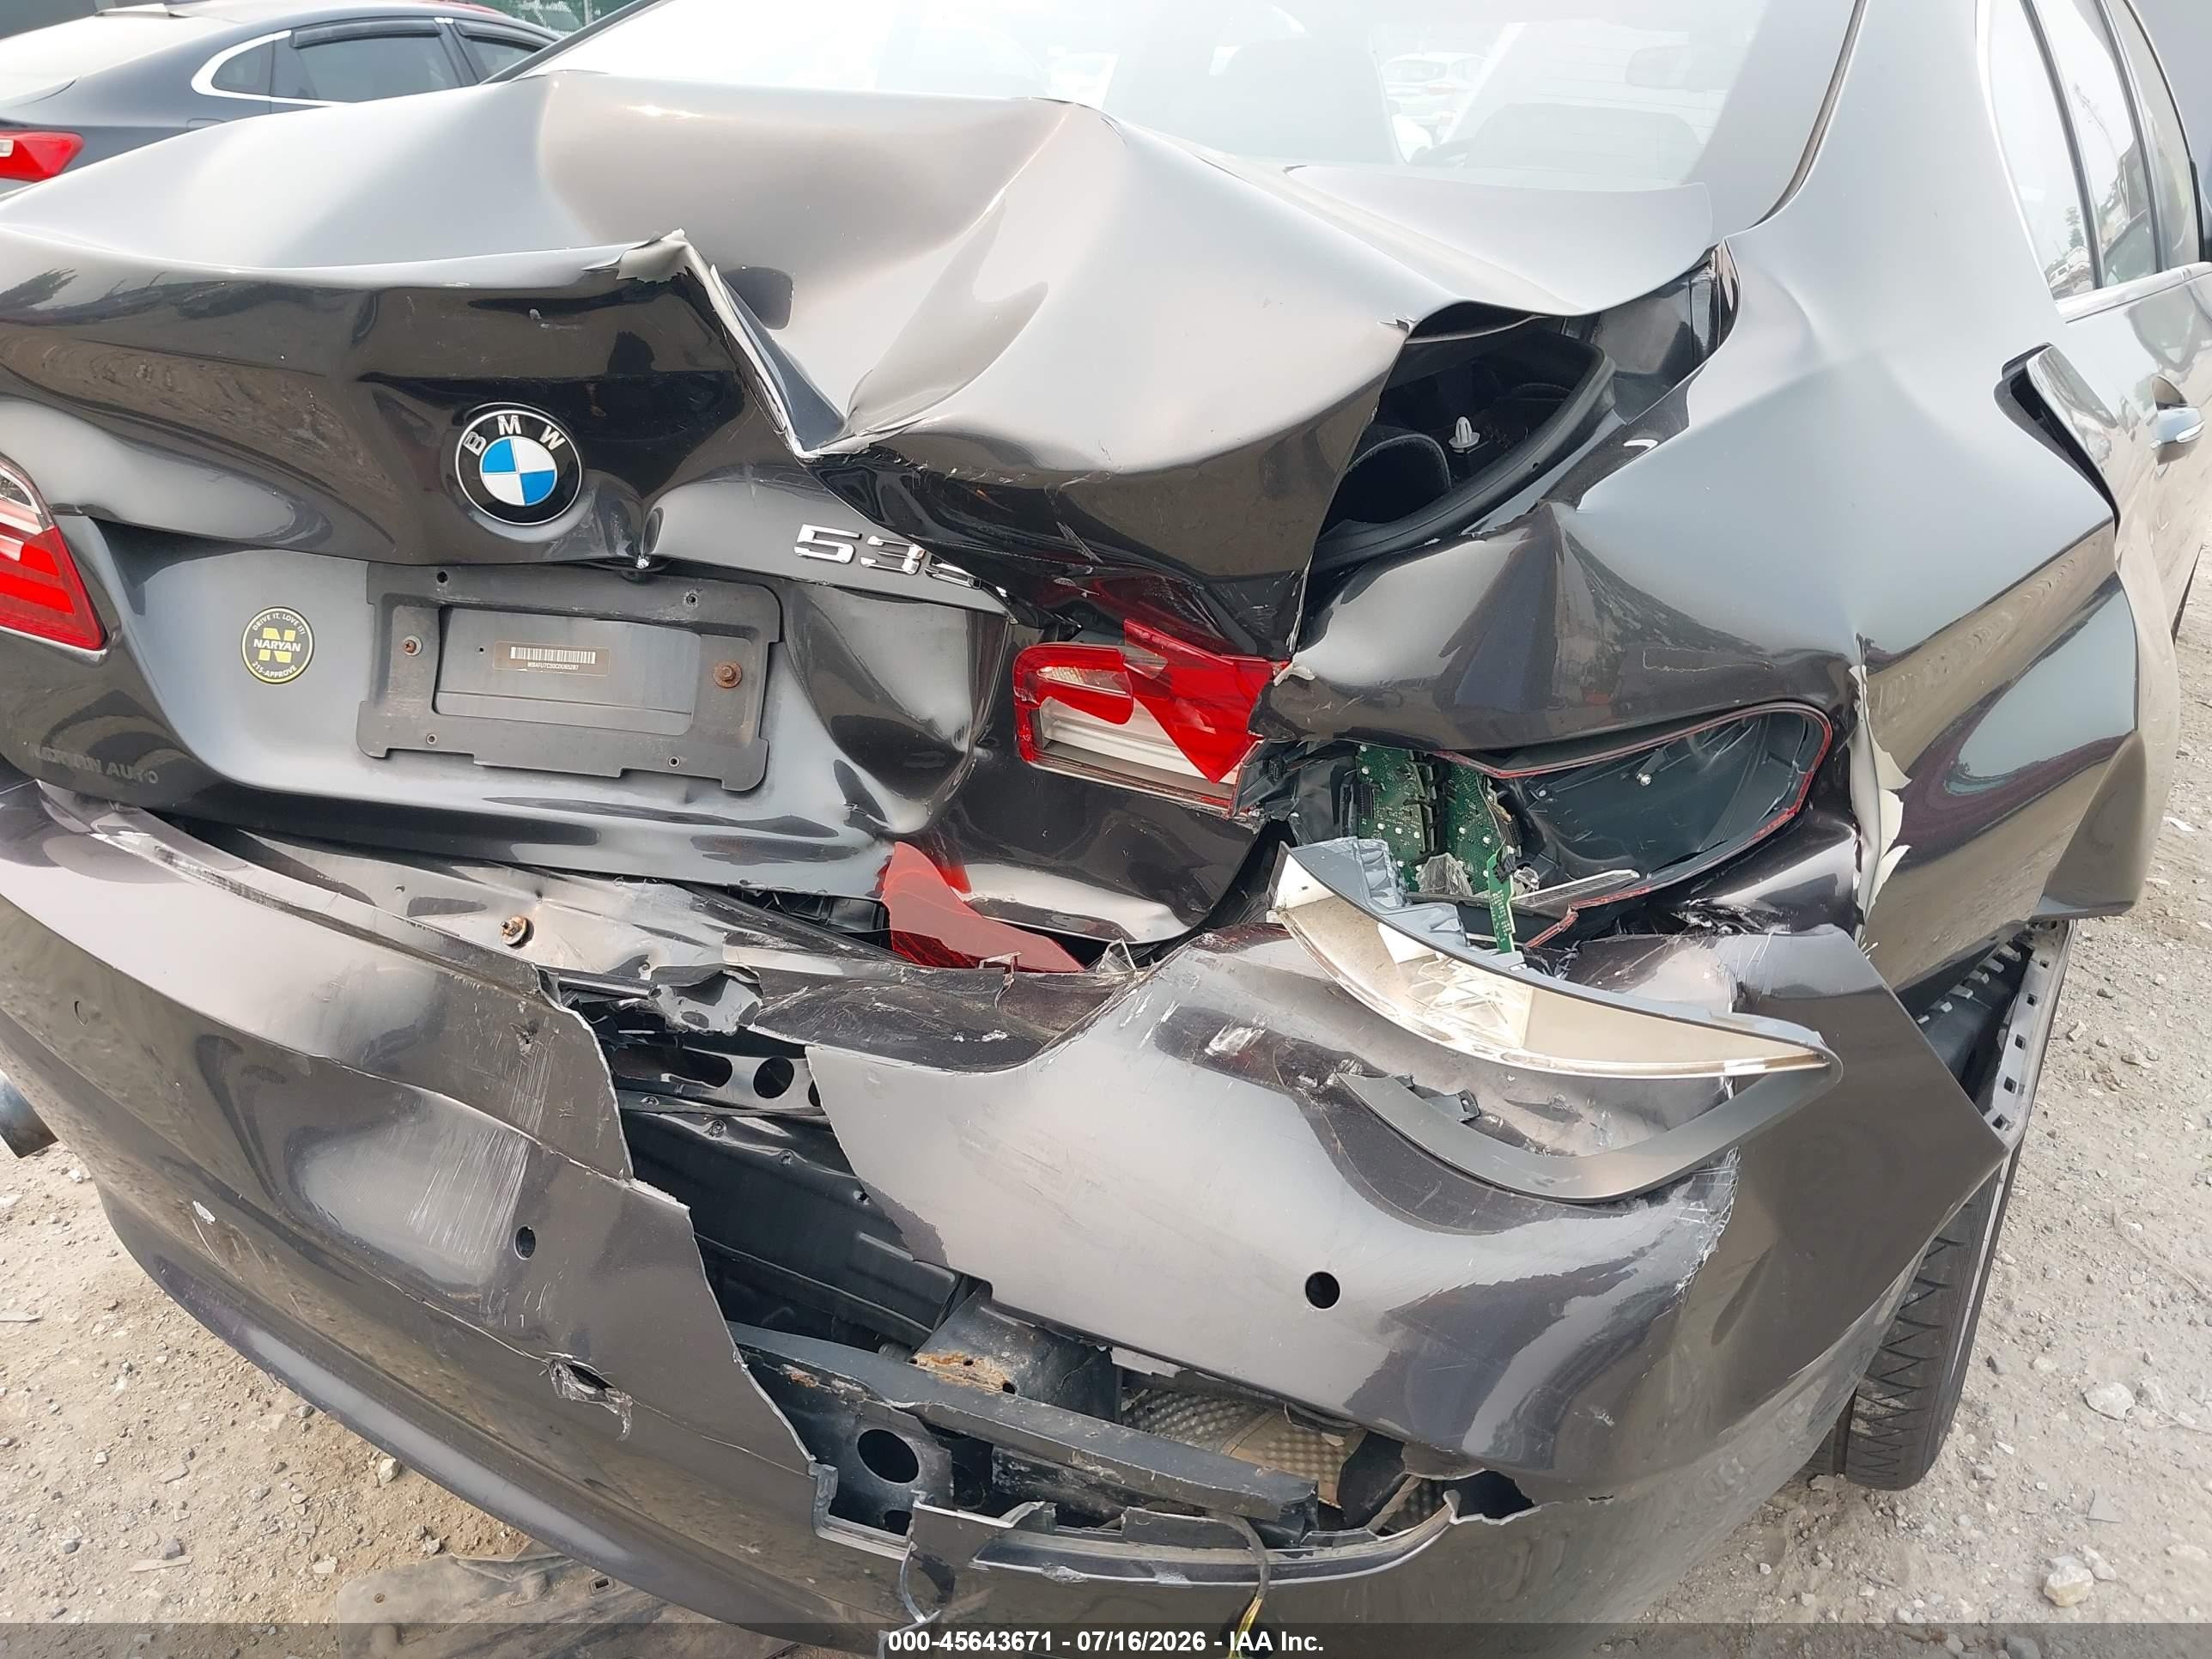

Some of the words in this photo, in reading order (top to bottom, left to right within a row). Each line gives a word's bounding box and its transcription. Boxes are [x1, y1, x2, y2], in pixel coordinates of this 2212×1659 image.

[463, 415, 566, 457] BMW
[252, 614, 271, 631] DRIVE
[283, 614, 298, 627] LOVE
[253, 638, 301, 653] NARYAN
[252, 660, 297, 678] 215-APPROVE
